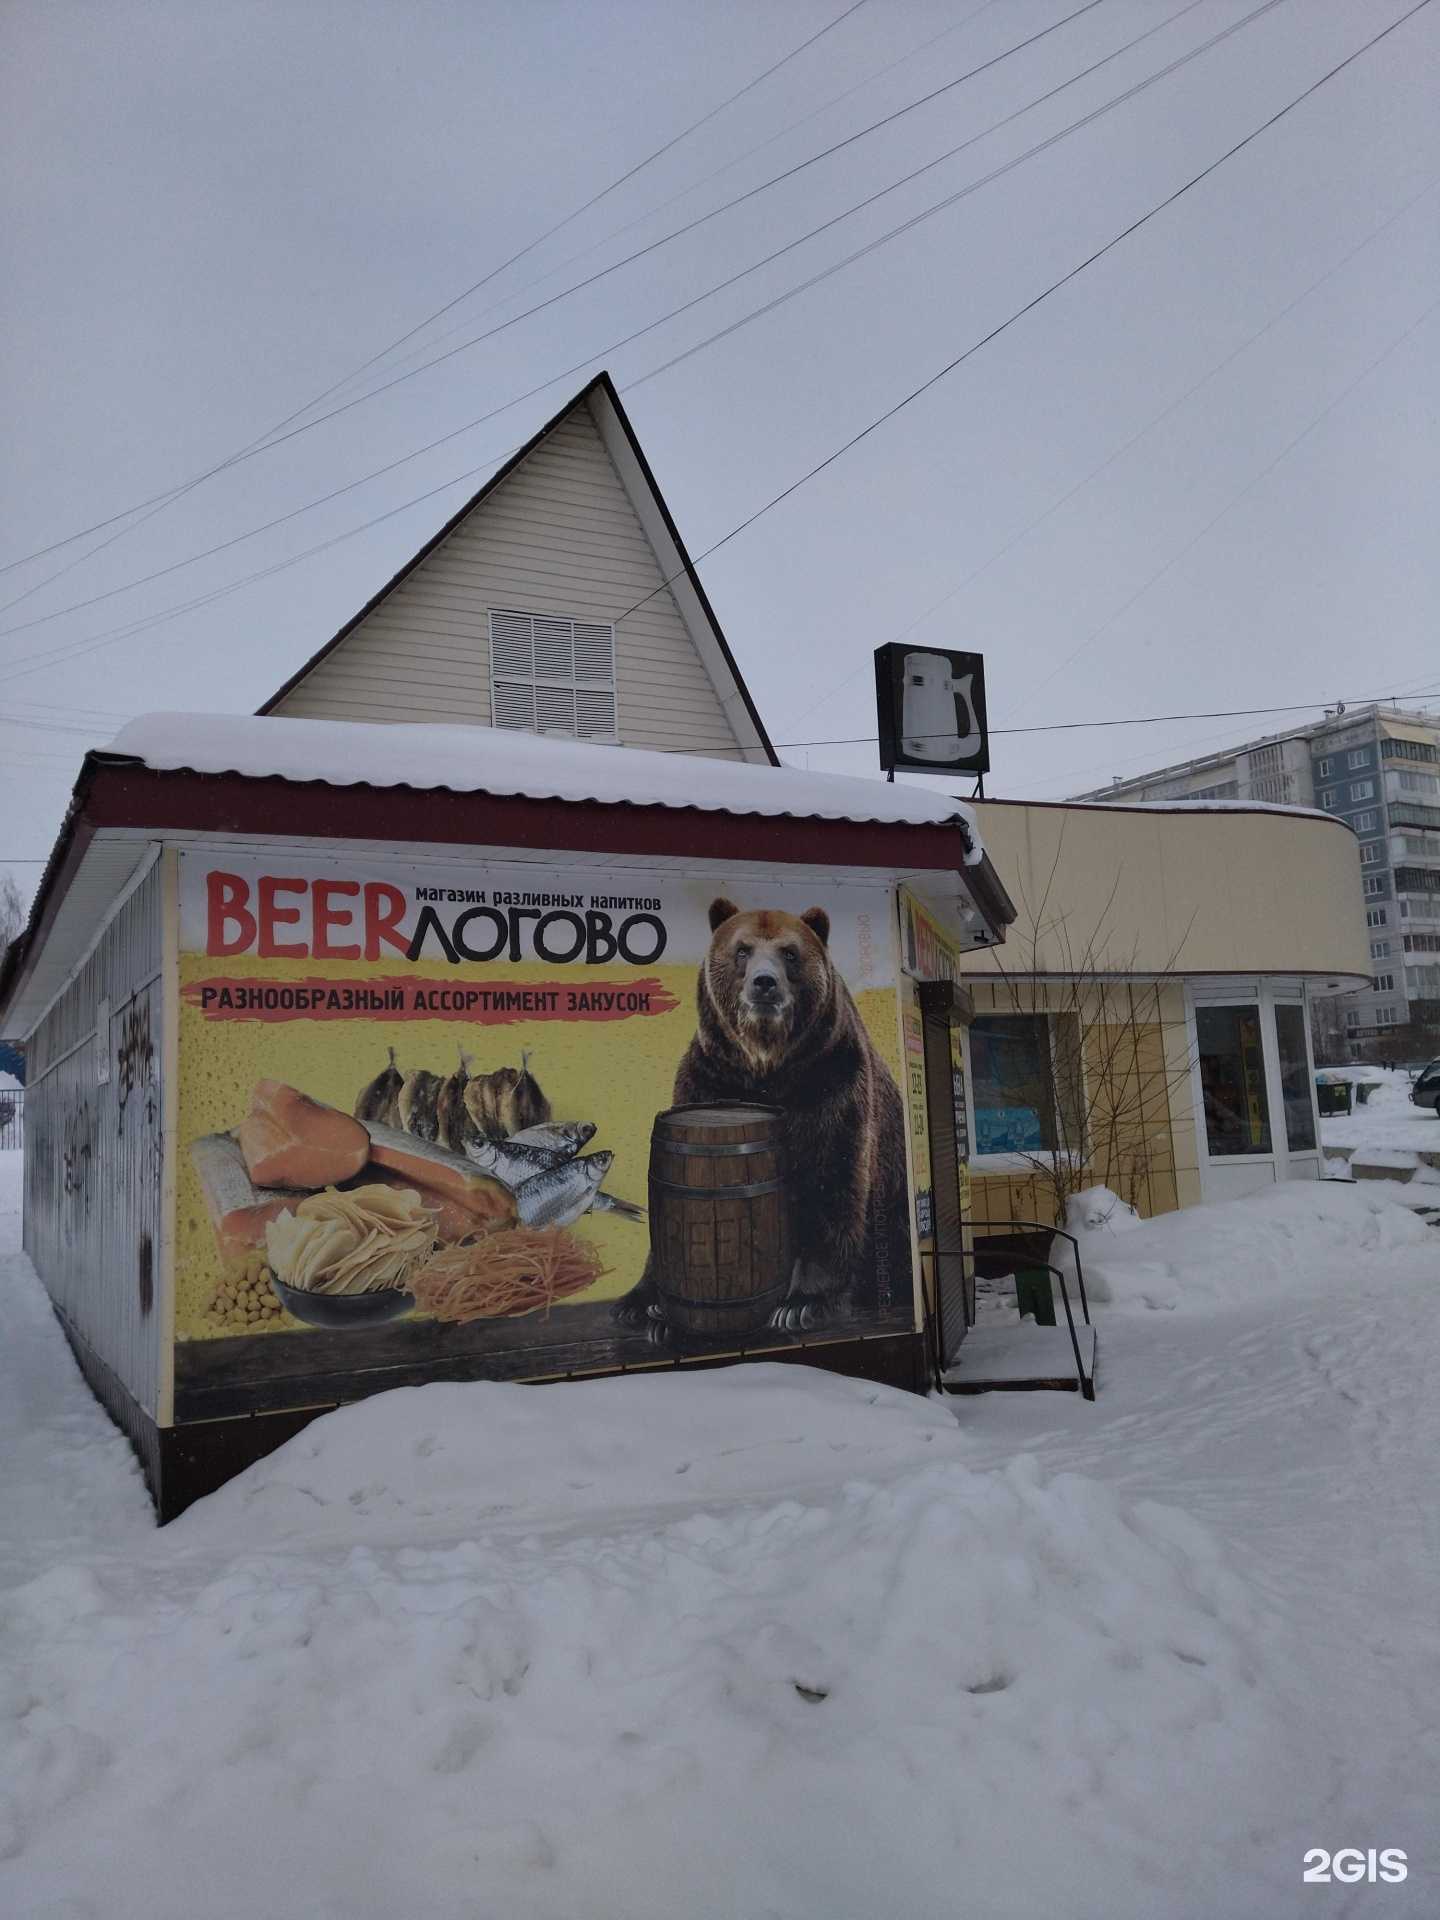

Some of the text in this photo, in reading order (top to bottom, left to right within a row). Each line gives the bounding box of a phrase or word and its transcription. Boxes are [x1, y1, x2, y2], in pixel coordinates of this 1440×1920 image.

[415, 887, 662, 911] магазин разливных напитков
[206, 871, 667, 965] BEER ЛОГОВО
[202, 986, 651, 1012] РАЗНООБРАЗНЫЙ АССОРТИМЕНТ ЗАКУСОК
